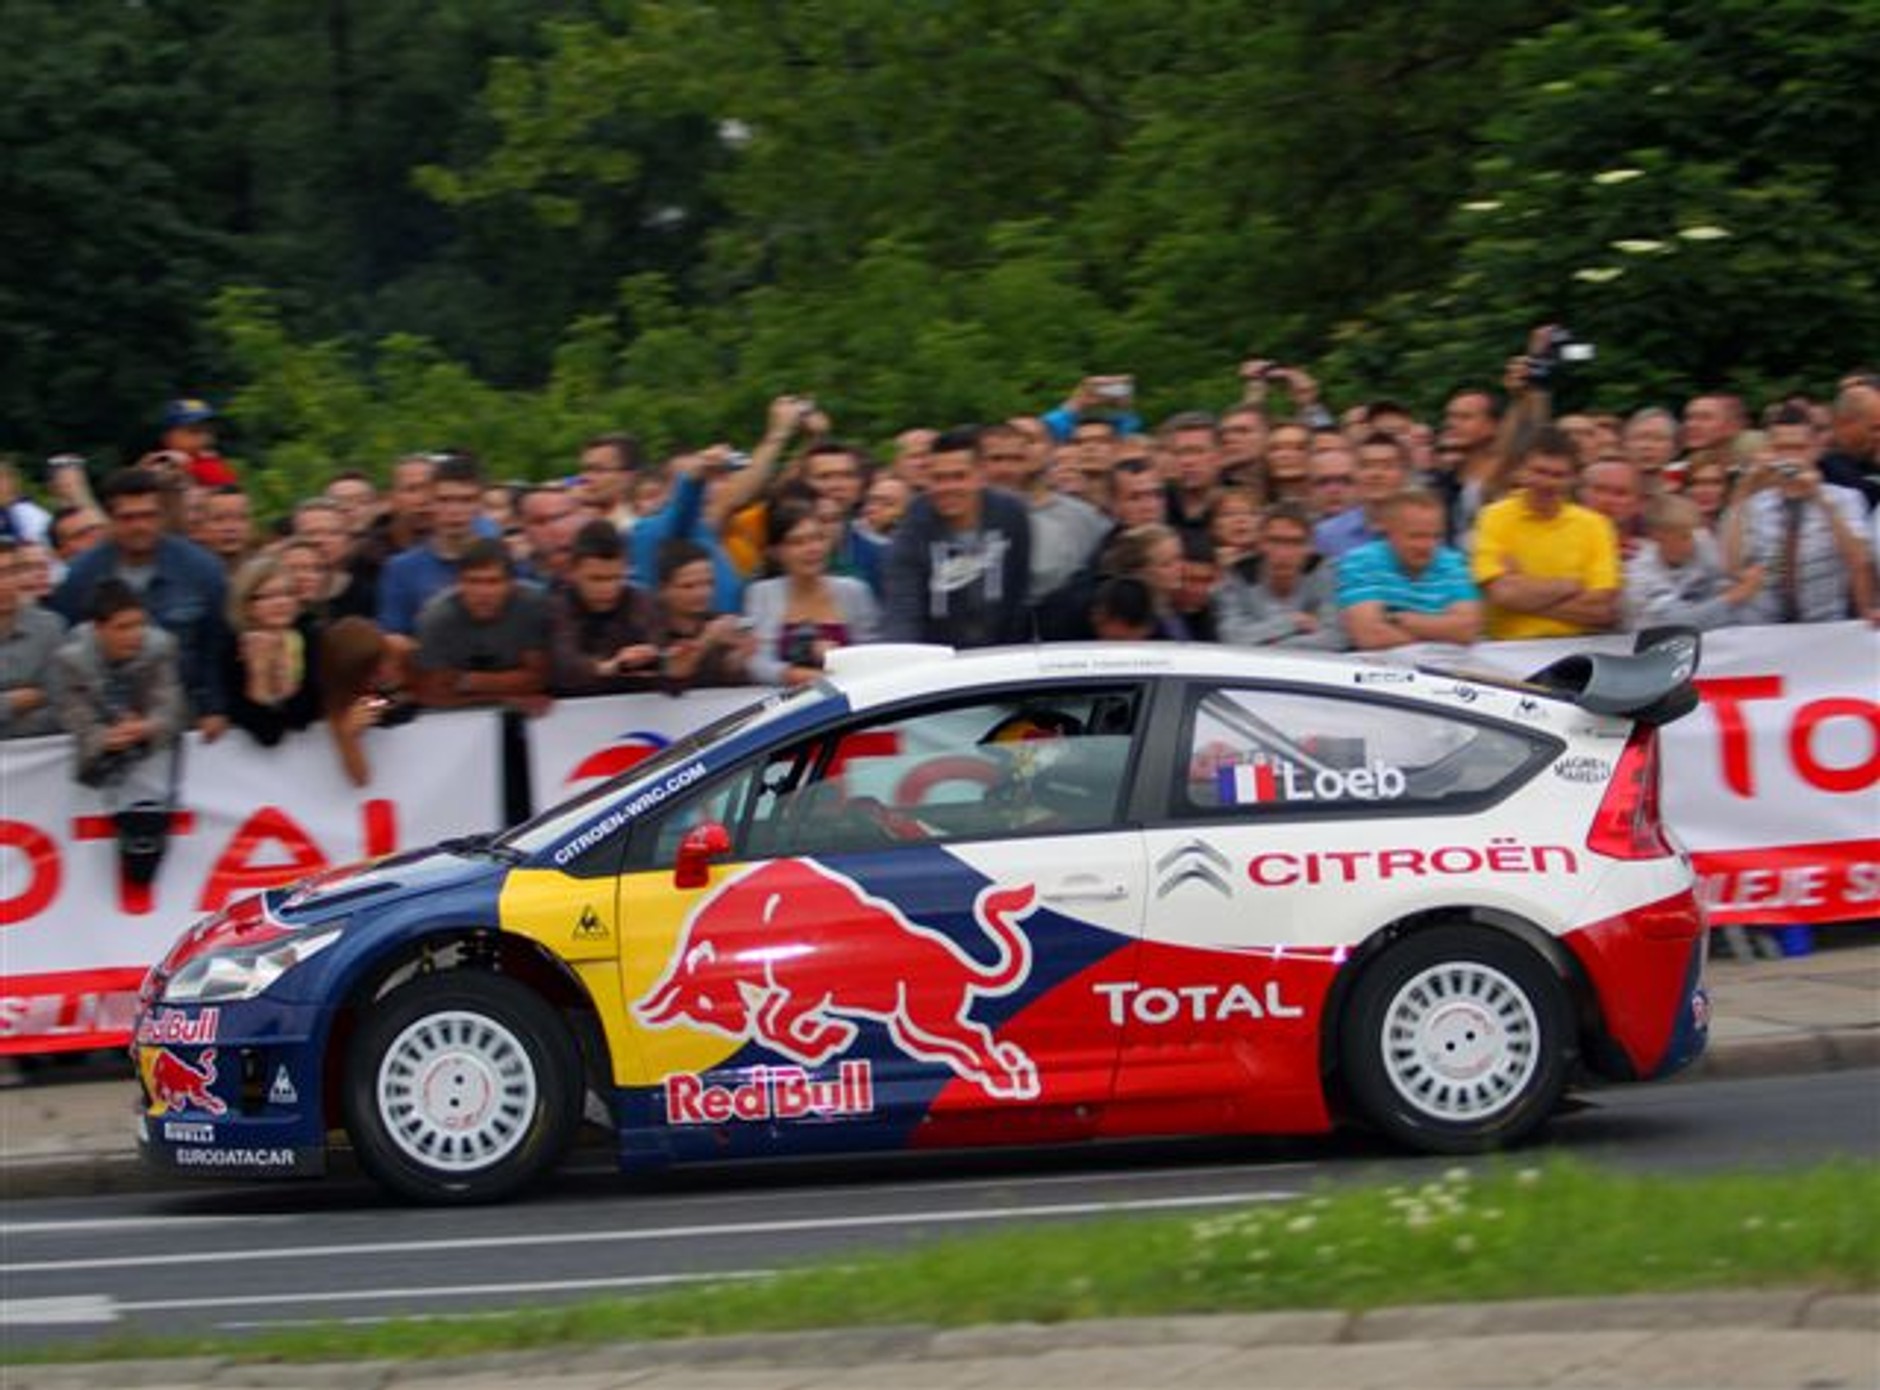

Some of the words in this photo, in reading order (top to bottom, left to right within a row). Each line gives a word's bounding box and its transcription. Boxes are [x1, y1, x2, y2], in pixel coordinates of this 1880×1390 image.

[1282, 759, 1406, 801] Loeb
[554, 762, 707, 865] CITROEN-WRC.COM
[1092, 980, 1304, 1027] TOTAL
[665, 1064, 770, 1123] Red
[772, 1058, 874, 1118] Bull
